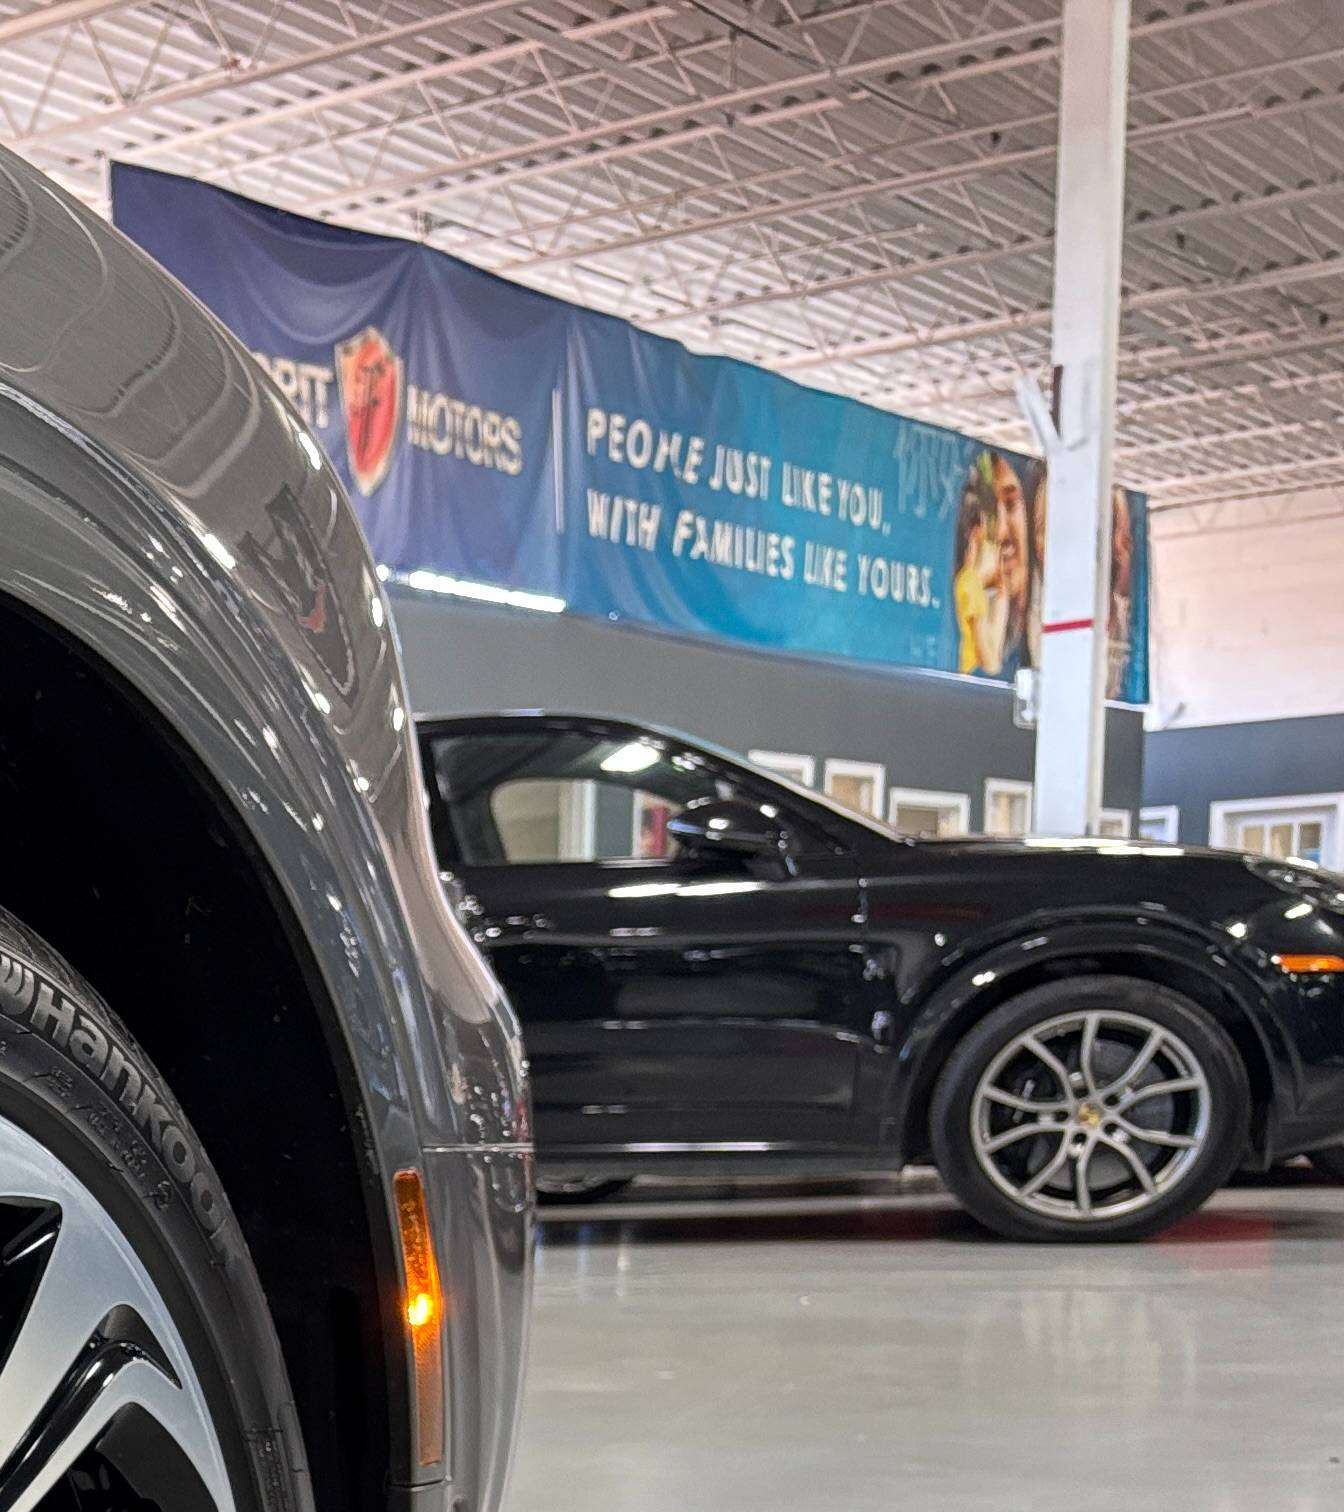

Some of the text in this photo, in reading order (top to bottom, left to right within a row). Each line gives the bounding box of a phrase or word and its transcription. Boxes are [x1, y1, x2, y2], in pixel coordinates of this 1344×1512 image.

[407, 384, 522, 476] MOTORS
[586, 407, 706, 485] PEOPLE
[709, 444, 772, 501] JUST
[781, 461, 832, 516] LIKE
[586, 487, 662, 553] WITH
[671, 508, 796, 581] FAMILIES
[802, 540, 849, 593] LIKE
